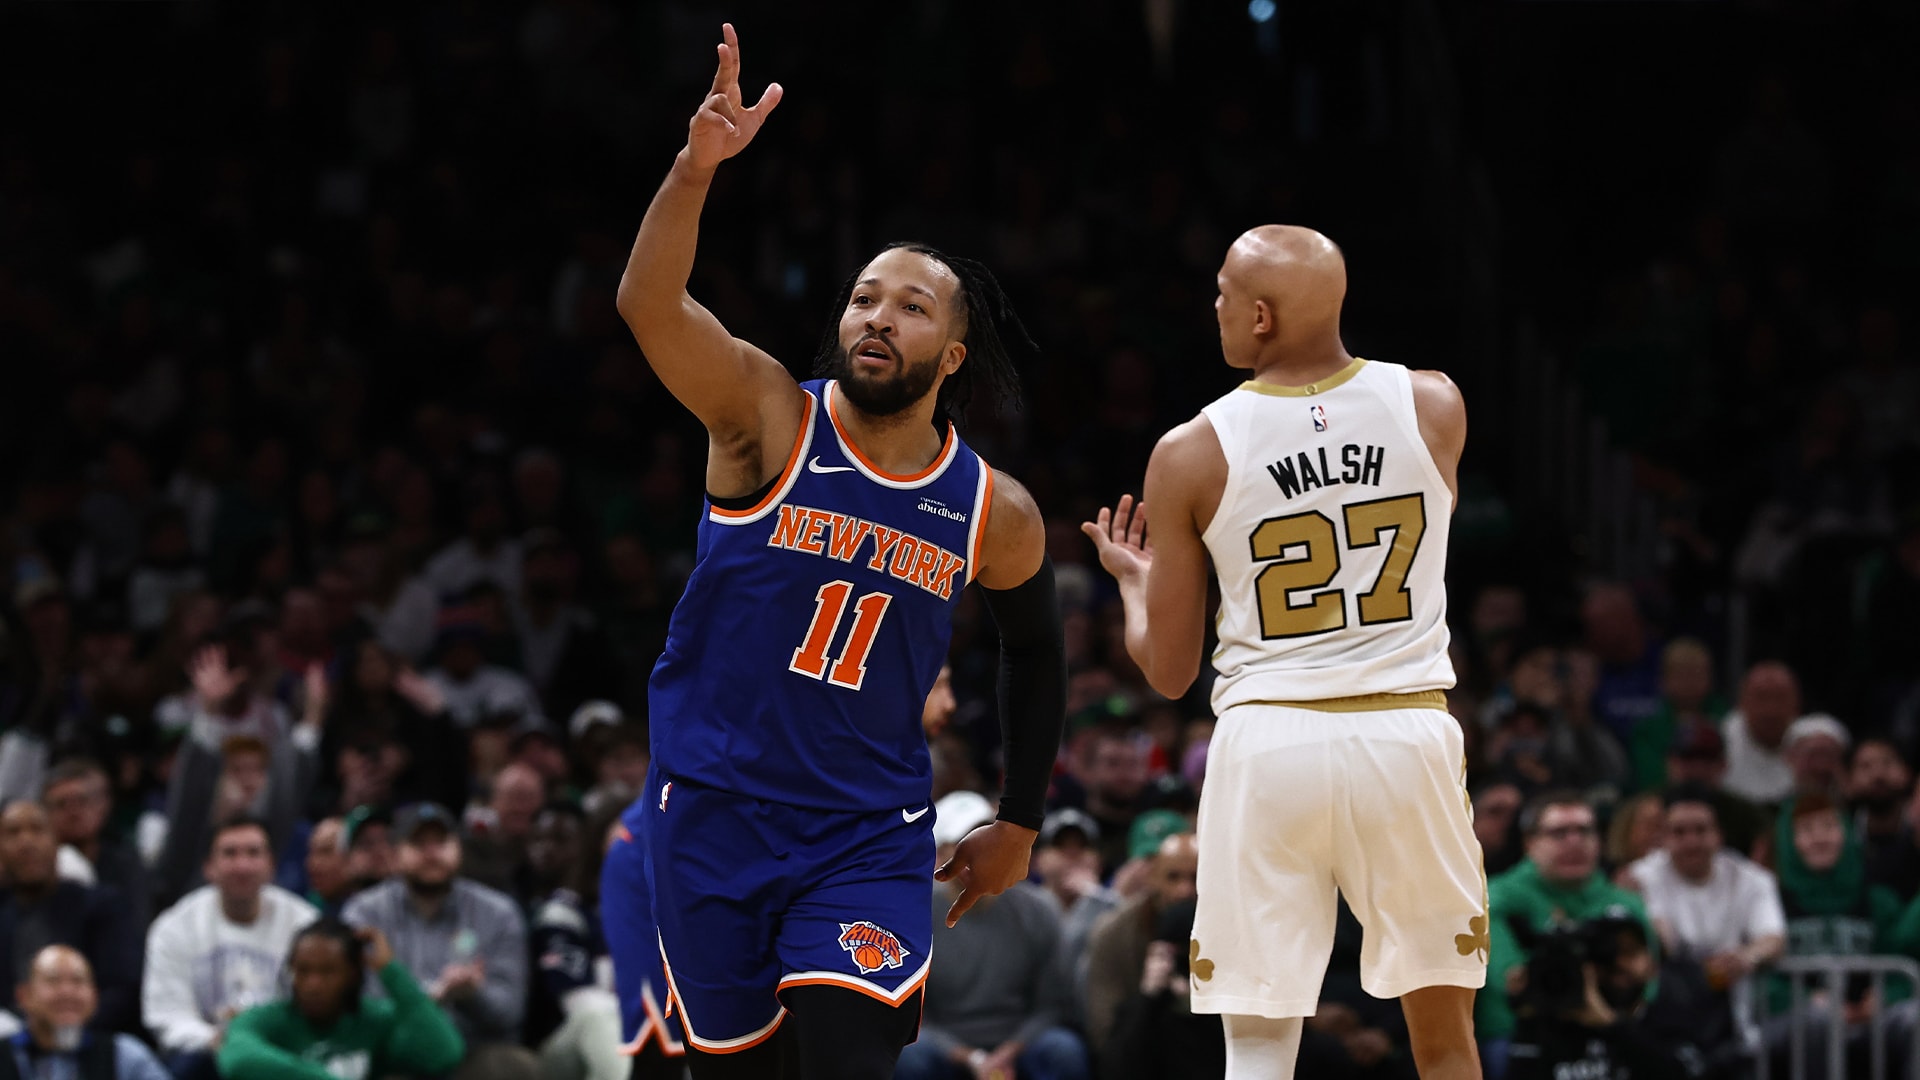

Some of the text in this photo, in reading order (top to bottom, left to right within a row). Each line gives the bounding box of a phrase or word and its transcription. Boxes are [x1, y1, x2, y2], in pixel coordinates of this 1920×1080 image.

[1267, 444, 1384, 500] WALSH
[917, 502, 967, 523] abu dhabi
[767, 503, 966, 602] NEW YORK
[1249, 492, 1427, 641] 27
[788, 580, 893, 691] 11
[841, 923, 900, 965] KNICKS
